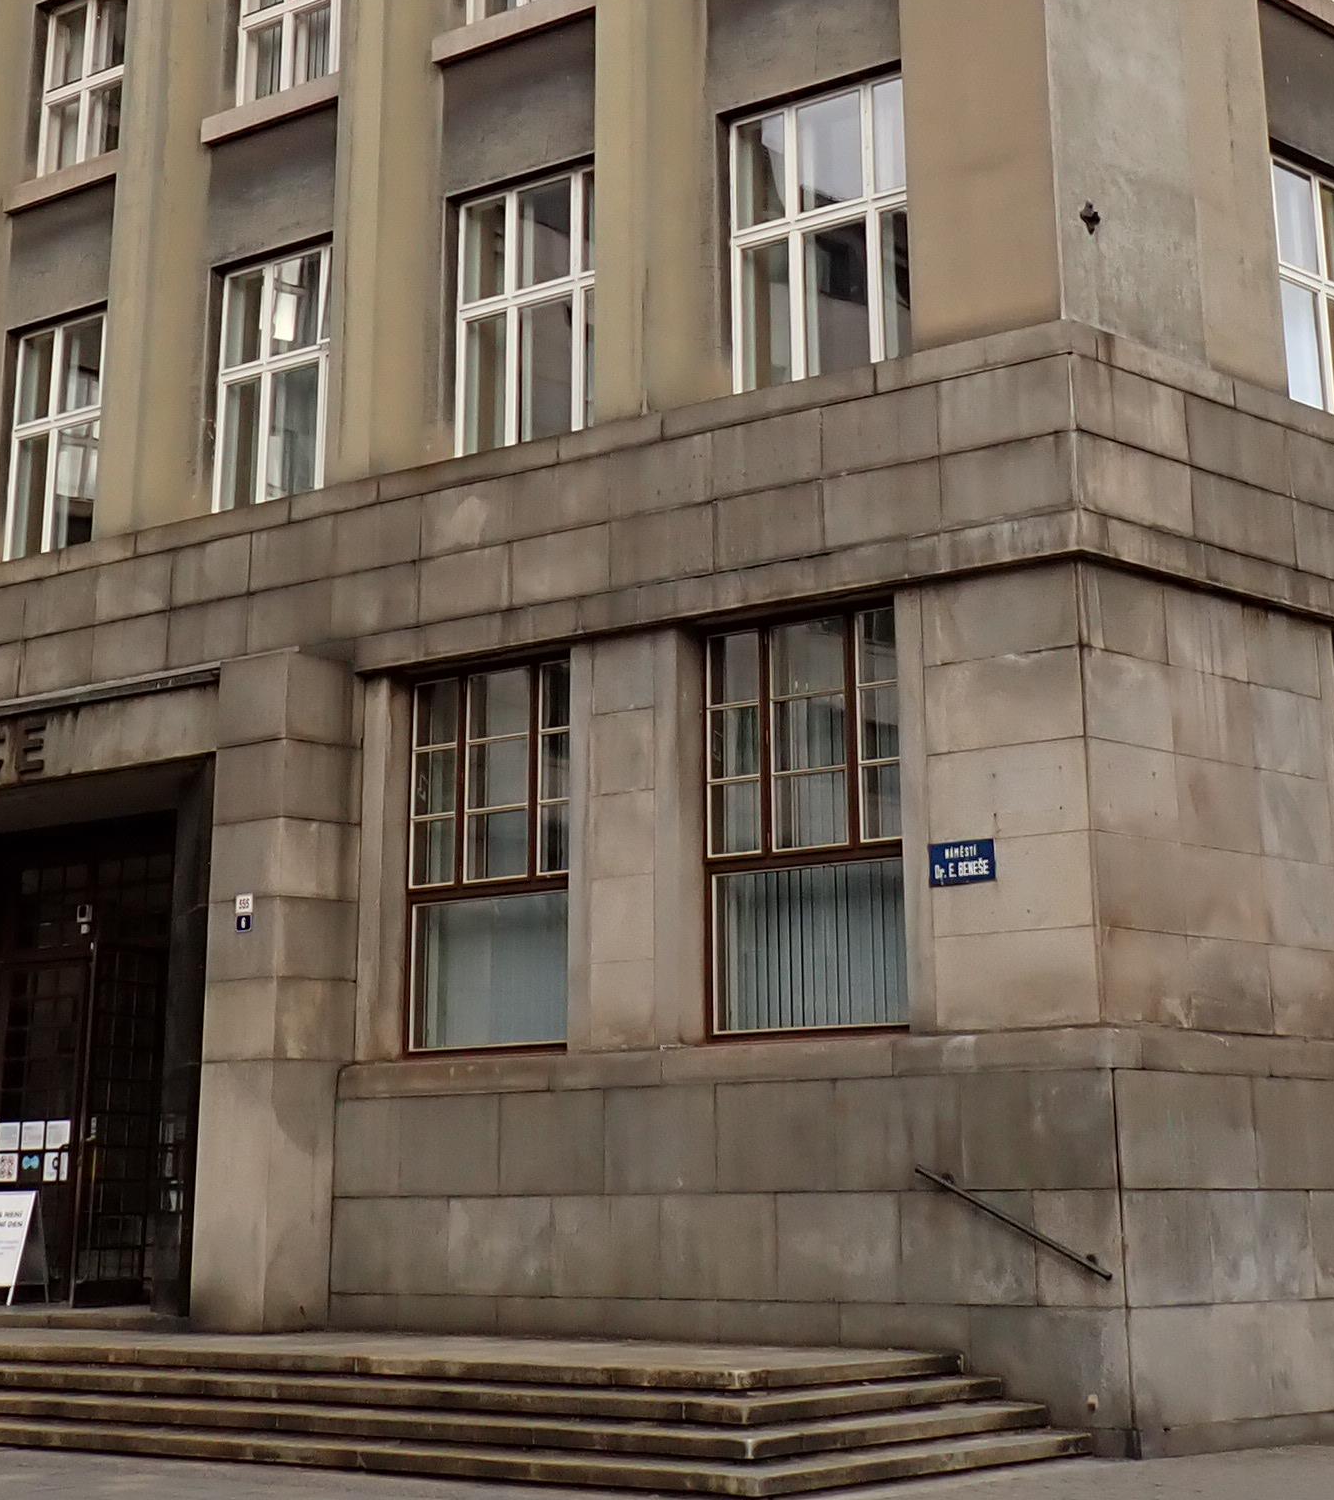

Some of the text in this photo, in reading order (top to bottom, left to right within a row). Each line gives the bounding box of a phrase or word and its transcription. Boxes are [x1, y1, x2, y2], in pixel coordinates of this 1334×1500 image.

[944, 844, 977, 859] NÁMĚSTÍ
[934, 858, 990, 879] Dr. E. BENEŠE
